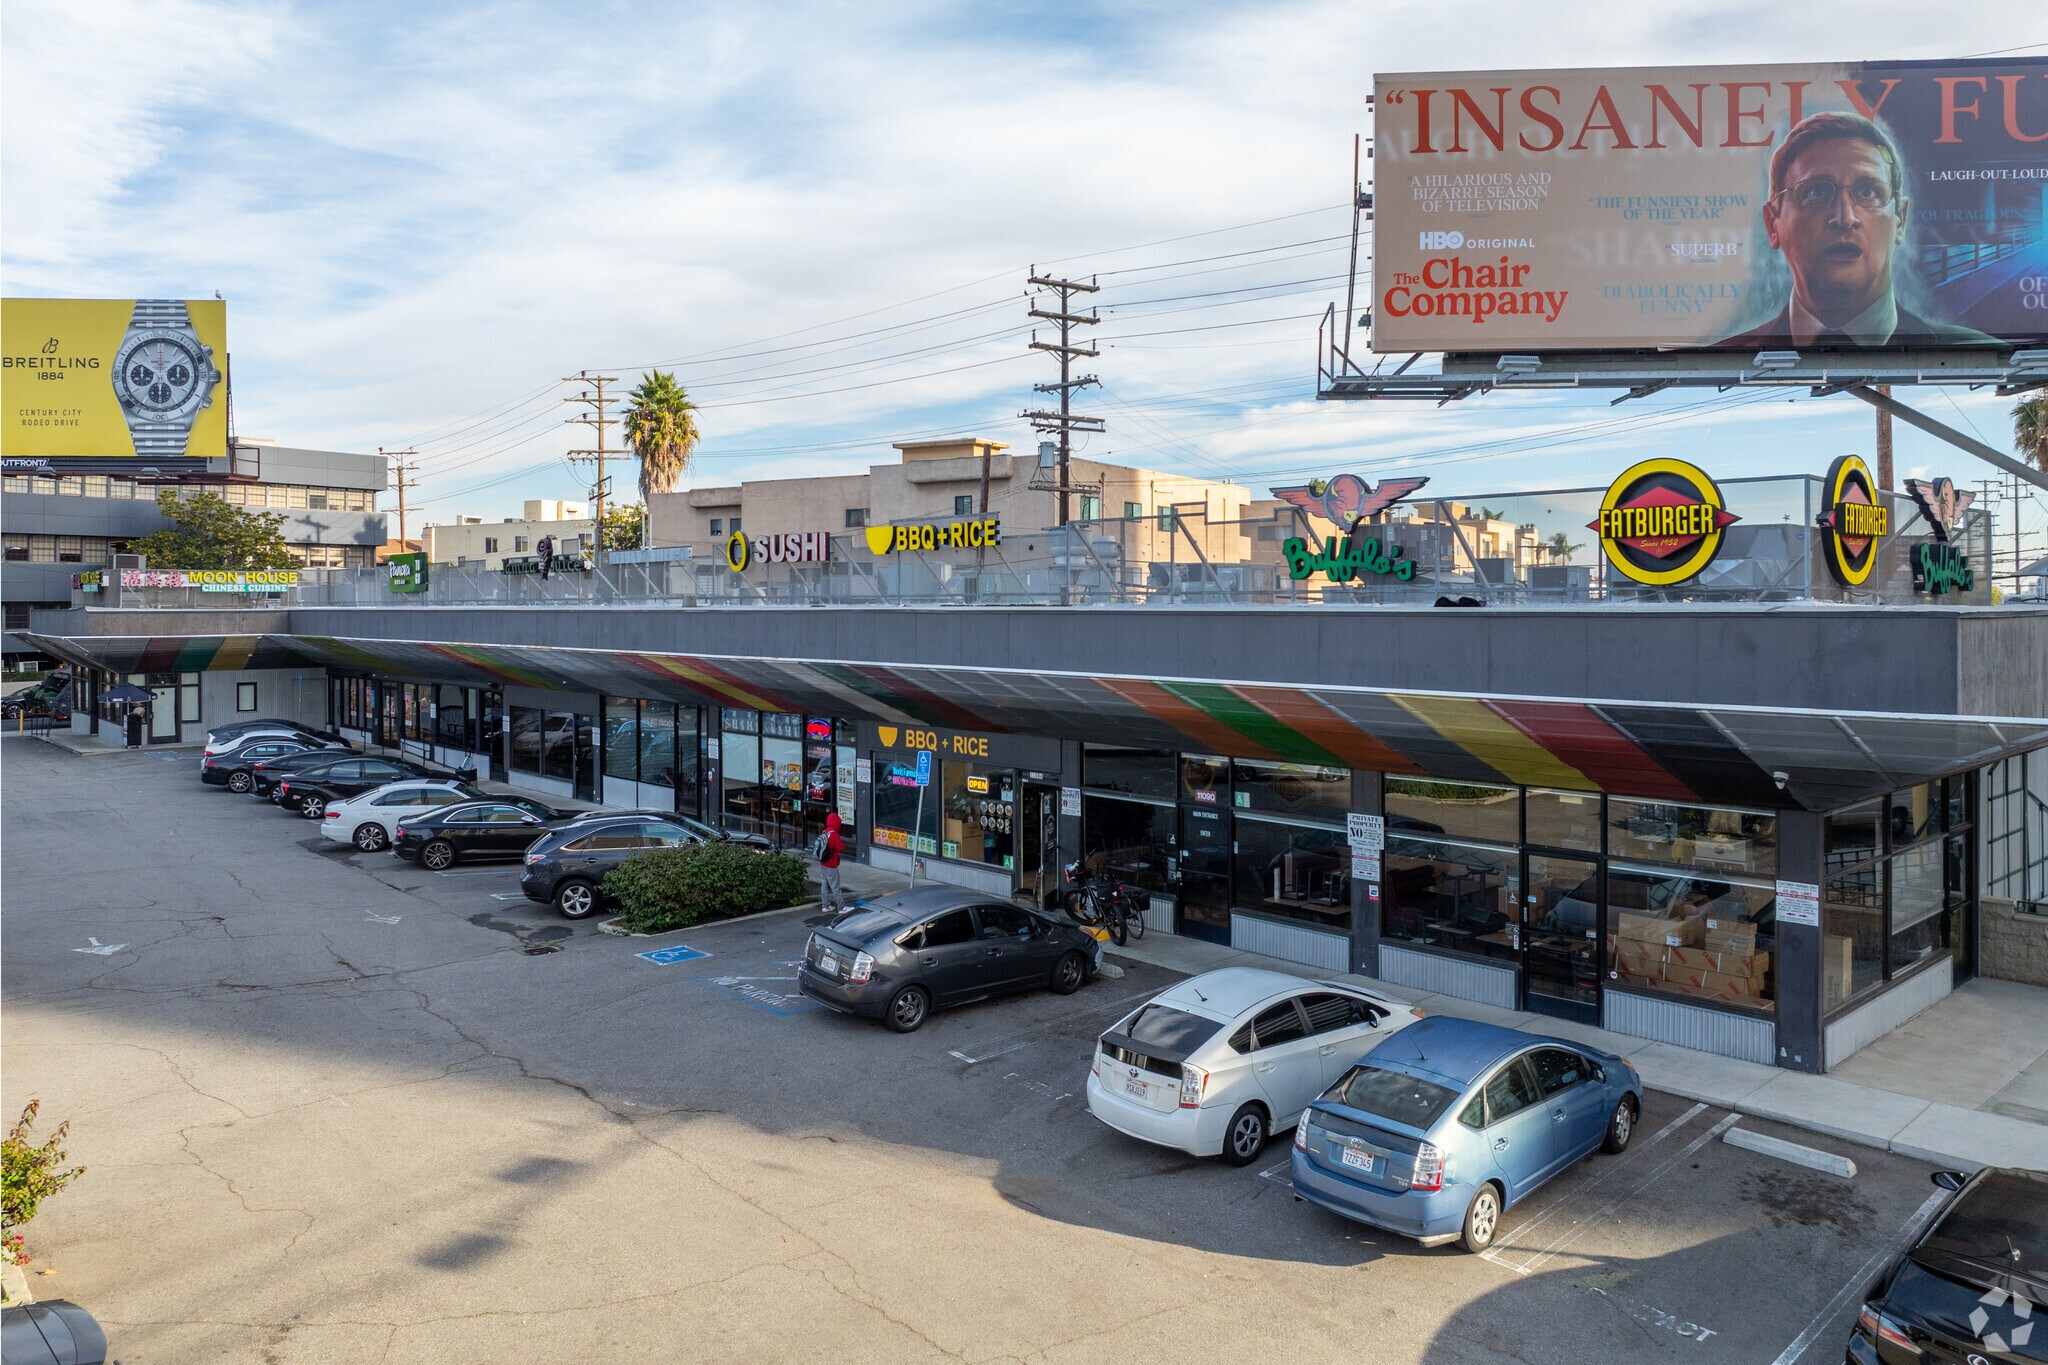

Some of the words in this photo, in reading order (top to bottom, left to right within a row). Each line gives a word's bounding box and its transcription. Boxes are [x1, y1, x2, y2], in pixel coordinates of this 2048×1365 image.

[1425, 173, 1512, 187] HILARIOUS
[1516, 172, 1552, 186] AND
[1413, 187, 1483, 200] BIZARRE
[1486, 185, 1548, 199] SEASON
[1422, 200, 1442, 213] OF
[1628, 195, 1698, 208] FUNNIEST
[1704, 194, 1748, 207] SHOW
[1623, 208, 1643, 220] OF
[1648, 208, 1676, 220] THE
[1420, 230, 1464, 250] HBO
[1466, 238, 1536, 249] ORIGINAL
[1393, 273, 1420, 285] The
[1422, 256, 1530, 289] Chair
[1384, 286, 1568, 323] Company
[2, 357, 99, 369] BREITLING
[37, 371, 64, 381] 1884
[1600, 504, 1714, 539] FATBURGER
[1845, 502, 1887, 536] FATBURGER
[754, 532, 829, 564] SUSHI
[1660, 538, 1679, 546] 1952
[1283, 536, 1417, 582] Buffalo's
[388, 561, 411, 578] Panera
[189, 571, 239, 584] MOON
[245, 571, 298, 584] HOUSE
[201, 584, 246, 592] CHINESE
[247, 584, 288, 592] CUISINE
[905, 729, 937, 751] BBQ
[953, 735, 988, 756] RICE
[968, 778, 987, 790] OPEN
[1196, 792, 1216, 801] 11090
[1236, 795, 1243, 804] A
[1349, 820, 1382, 829] PROPERTY
[1352, 814, 1379, 823] PRIVATE
[1350, 827, 1363, 839] NO
